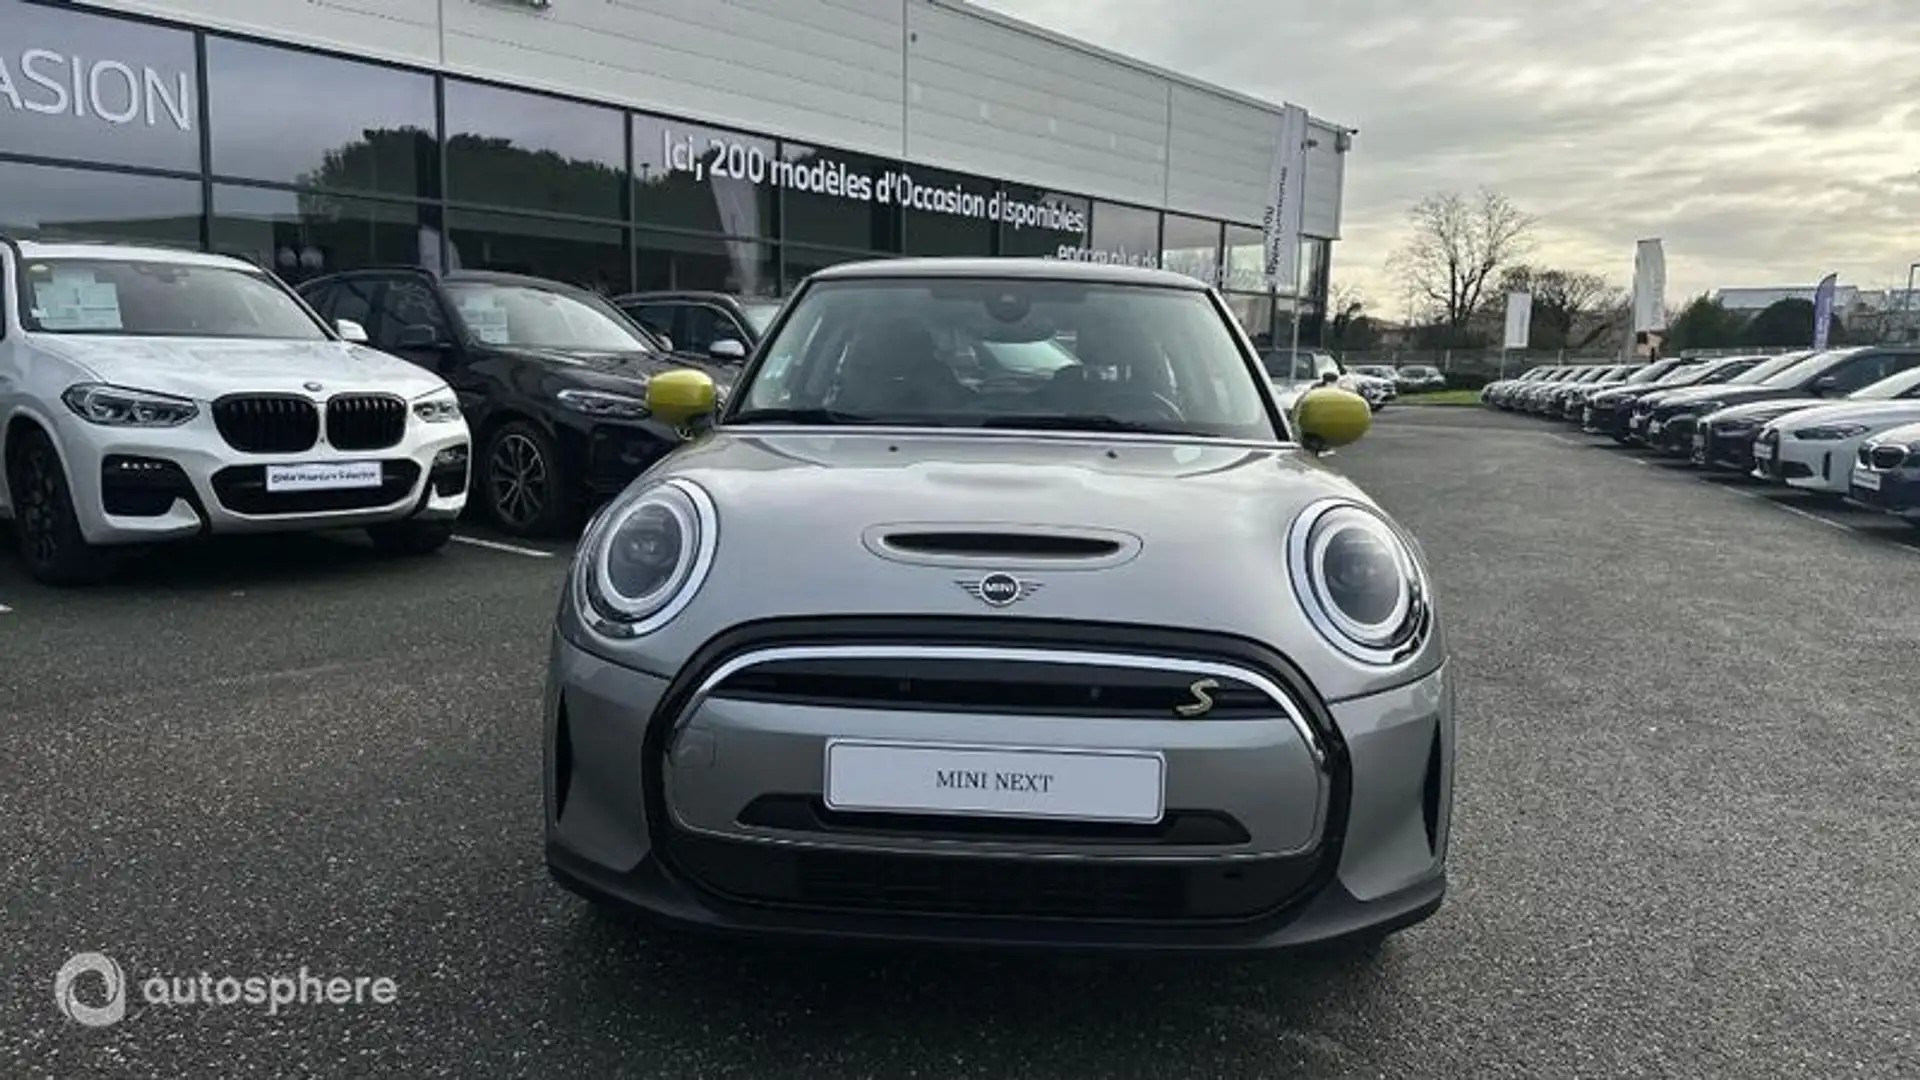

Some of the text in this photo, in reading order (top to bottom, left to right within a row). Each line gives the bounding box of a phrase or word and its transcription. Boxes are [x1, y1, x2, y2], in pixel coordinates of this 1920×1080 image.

[664, 130, 1086, 232] Ici, 200 modèles d'Occasion disponibles
[985, 582, 1015, 593] MINI
[1176, 678, 1219, 716] S
[936, 769, 1054, 793] MINI NEXT
